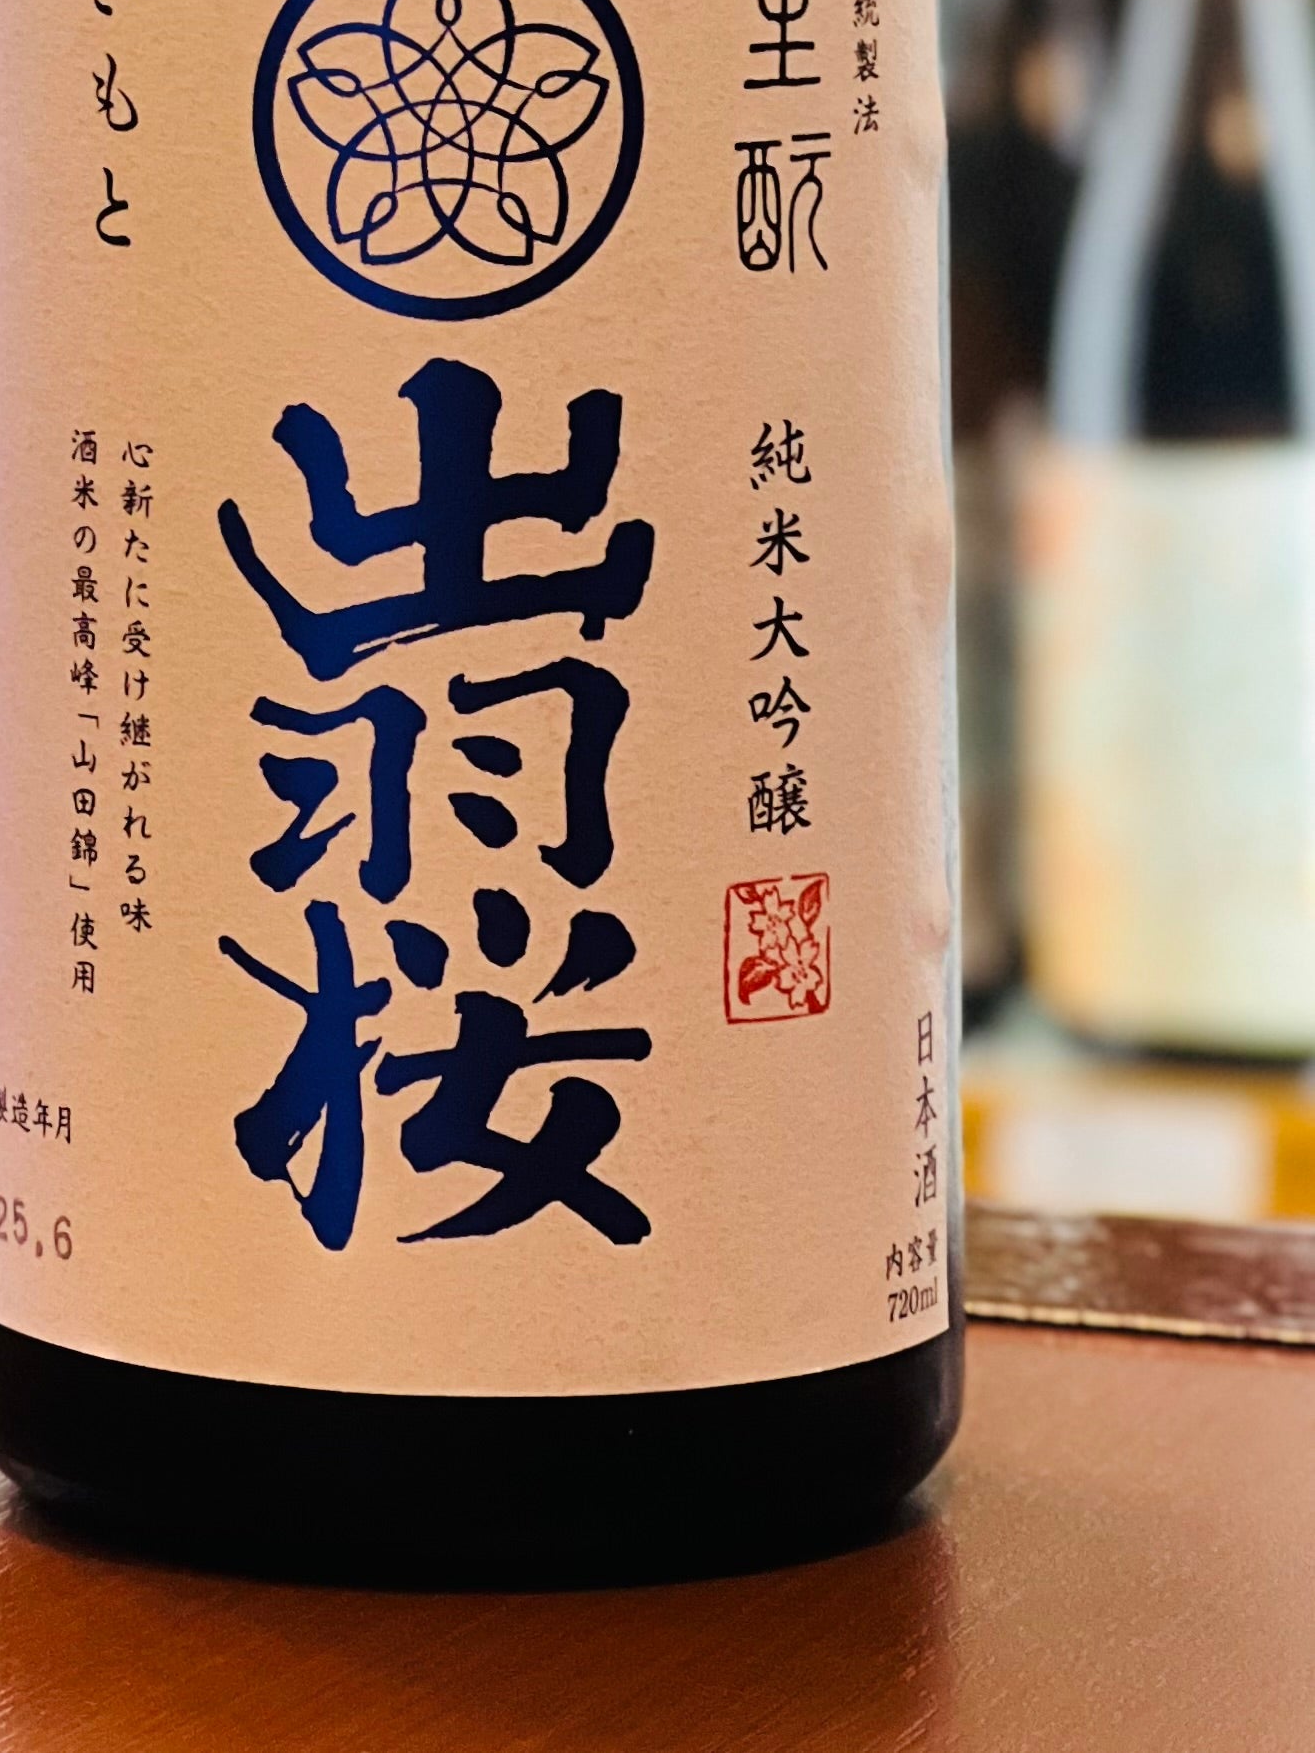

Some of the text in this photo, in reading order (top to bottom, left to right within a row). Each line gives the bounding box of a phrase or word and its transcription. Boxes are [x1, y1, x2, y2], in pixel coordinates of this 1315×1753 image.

[69, 429, 100, 994] 酒米の最高峰「山田錦」使用
[119, 440, 154, 933] 心新たに受け継がれる味
[217, 357, 656, 1251] 出羽桜
[747, 418, 813, 837] 純米大吟醸
[885, 1227, 939, 1281] 内容量
[887, 1276, 939, 1323] 720ml
[913, 1010, 938, 1208] 日本酒
